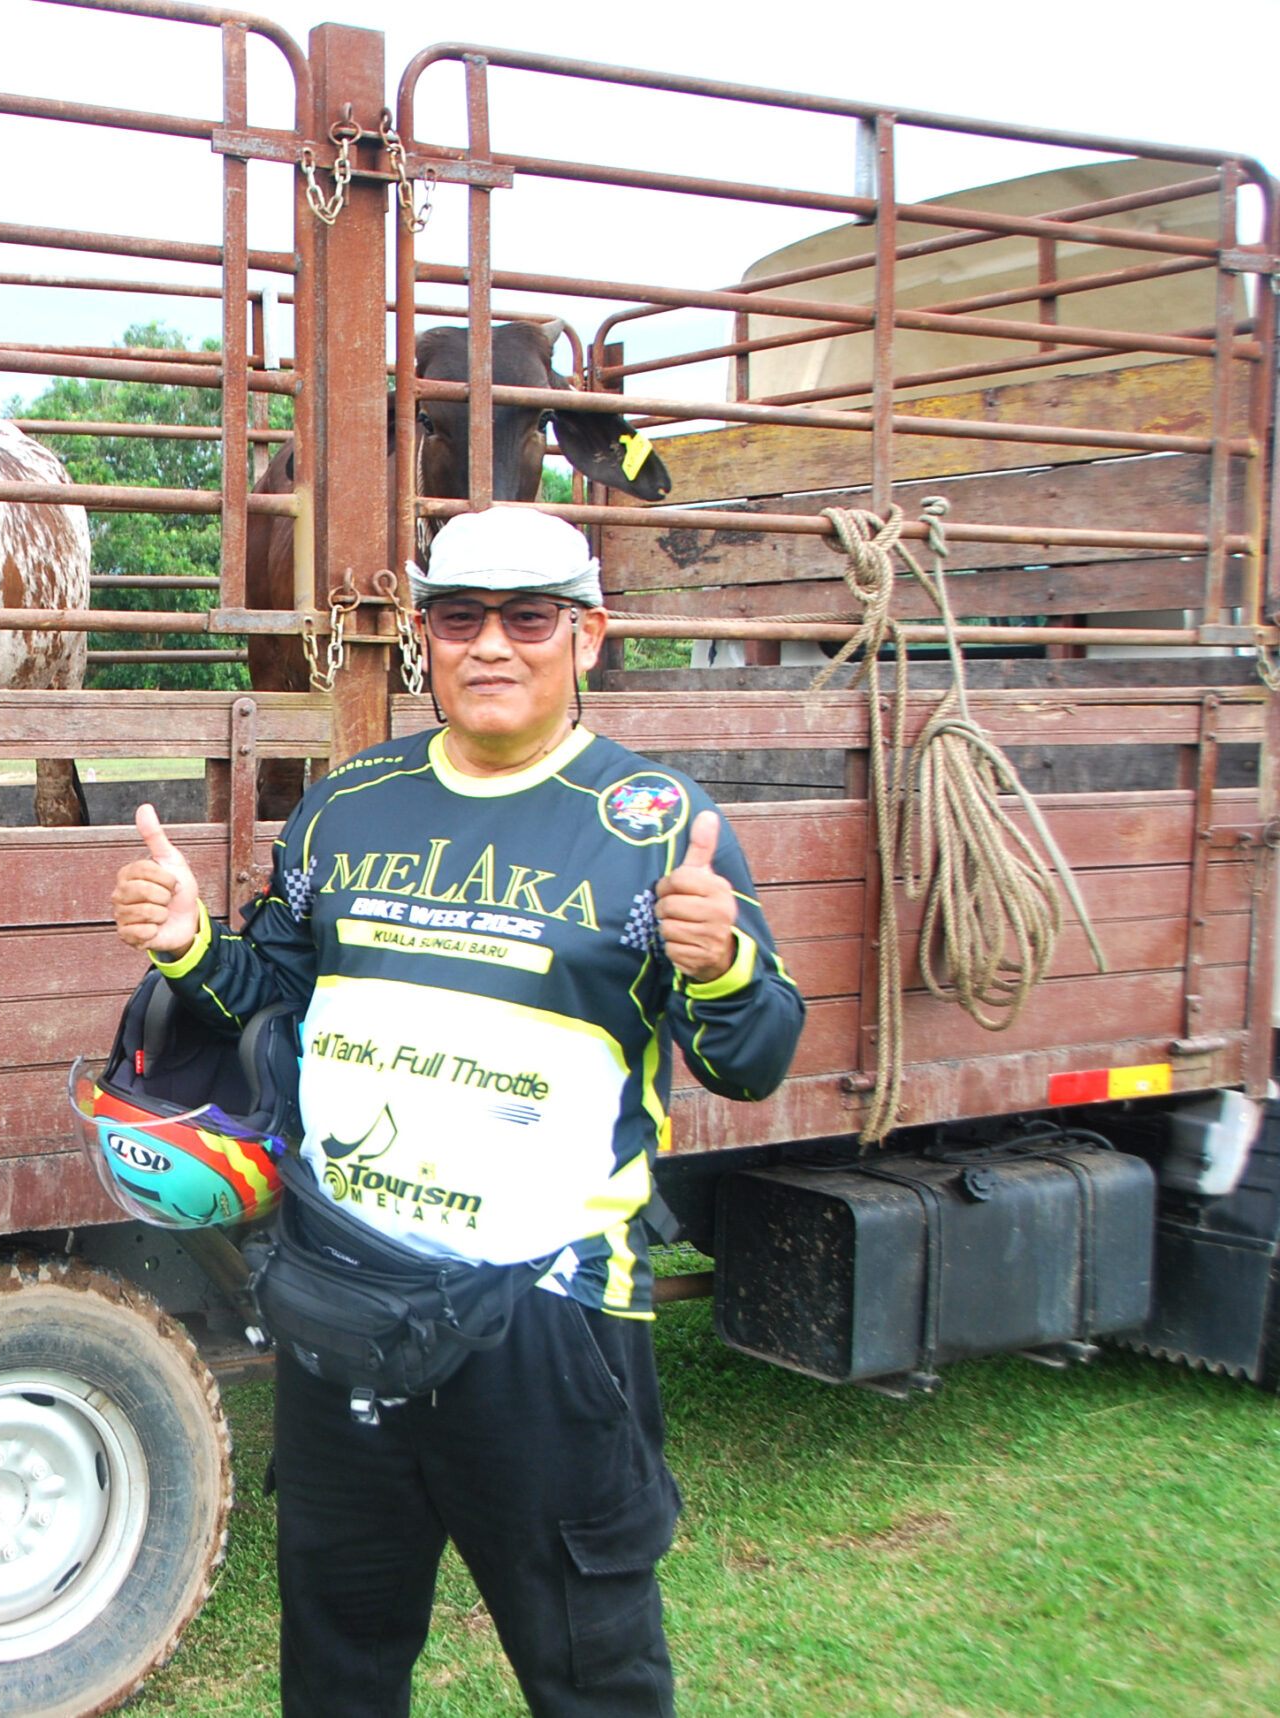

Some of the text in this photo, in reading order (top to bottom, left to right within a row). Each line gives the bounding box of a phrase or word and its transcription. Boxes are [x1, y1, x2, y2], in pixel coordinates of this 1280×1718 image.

[320, 838, 601, 932] MELAKA
[349, 897, 546, 940] BIKE WEEK 2025
[373, 930, 416, 948] KUALA
[468, 943, 509, 959] BARU
[391, 1045, 446, 1078] Full
[451, 1056, 549, 1101] Throttle
[347, 1163, 482, 1213] Tourism
[350, 1187, 478, 1230] MELAKA
